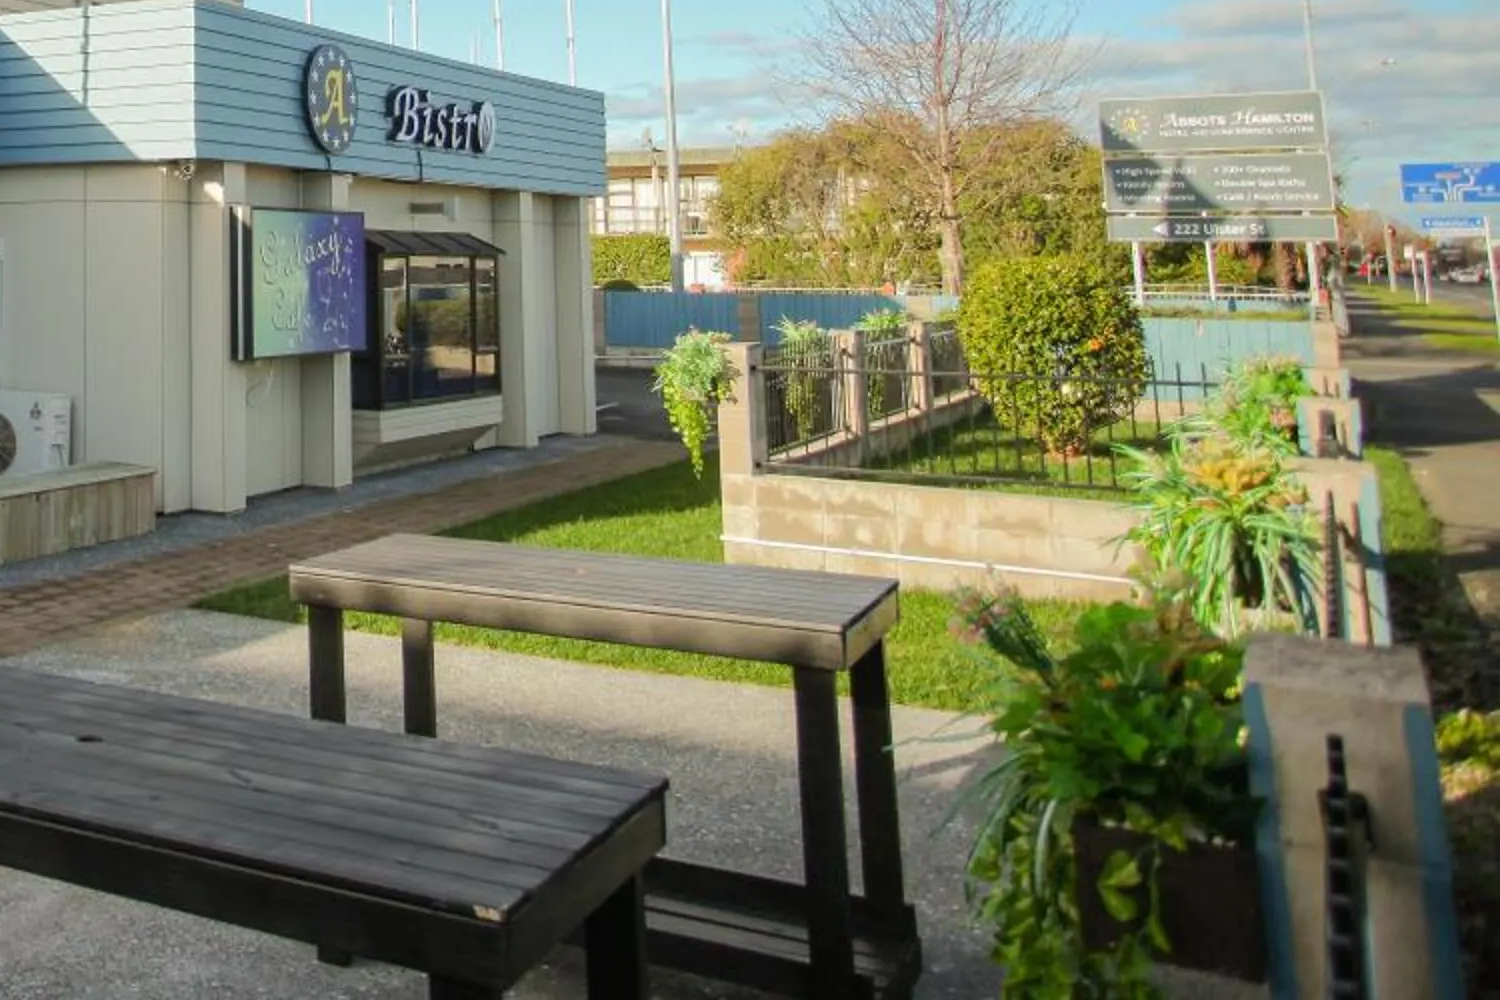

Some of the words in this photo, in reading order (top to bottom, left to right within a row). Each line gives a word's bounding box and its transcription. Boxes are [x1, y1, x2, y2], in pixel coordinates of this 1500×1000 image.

[321, 67, 348, 125] A
[394, 86, 496, 152] Bistro
[1174, 223, 1200, 235] 222
